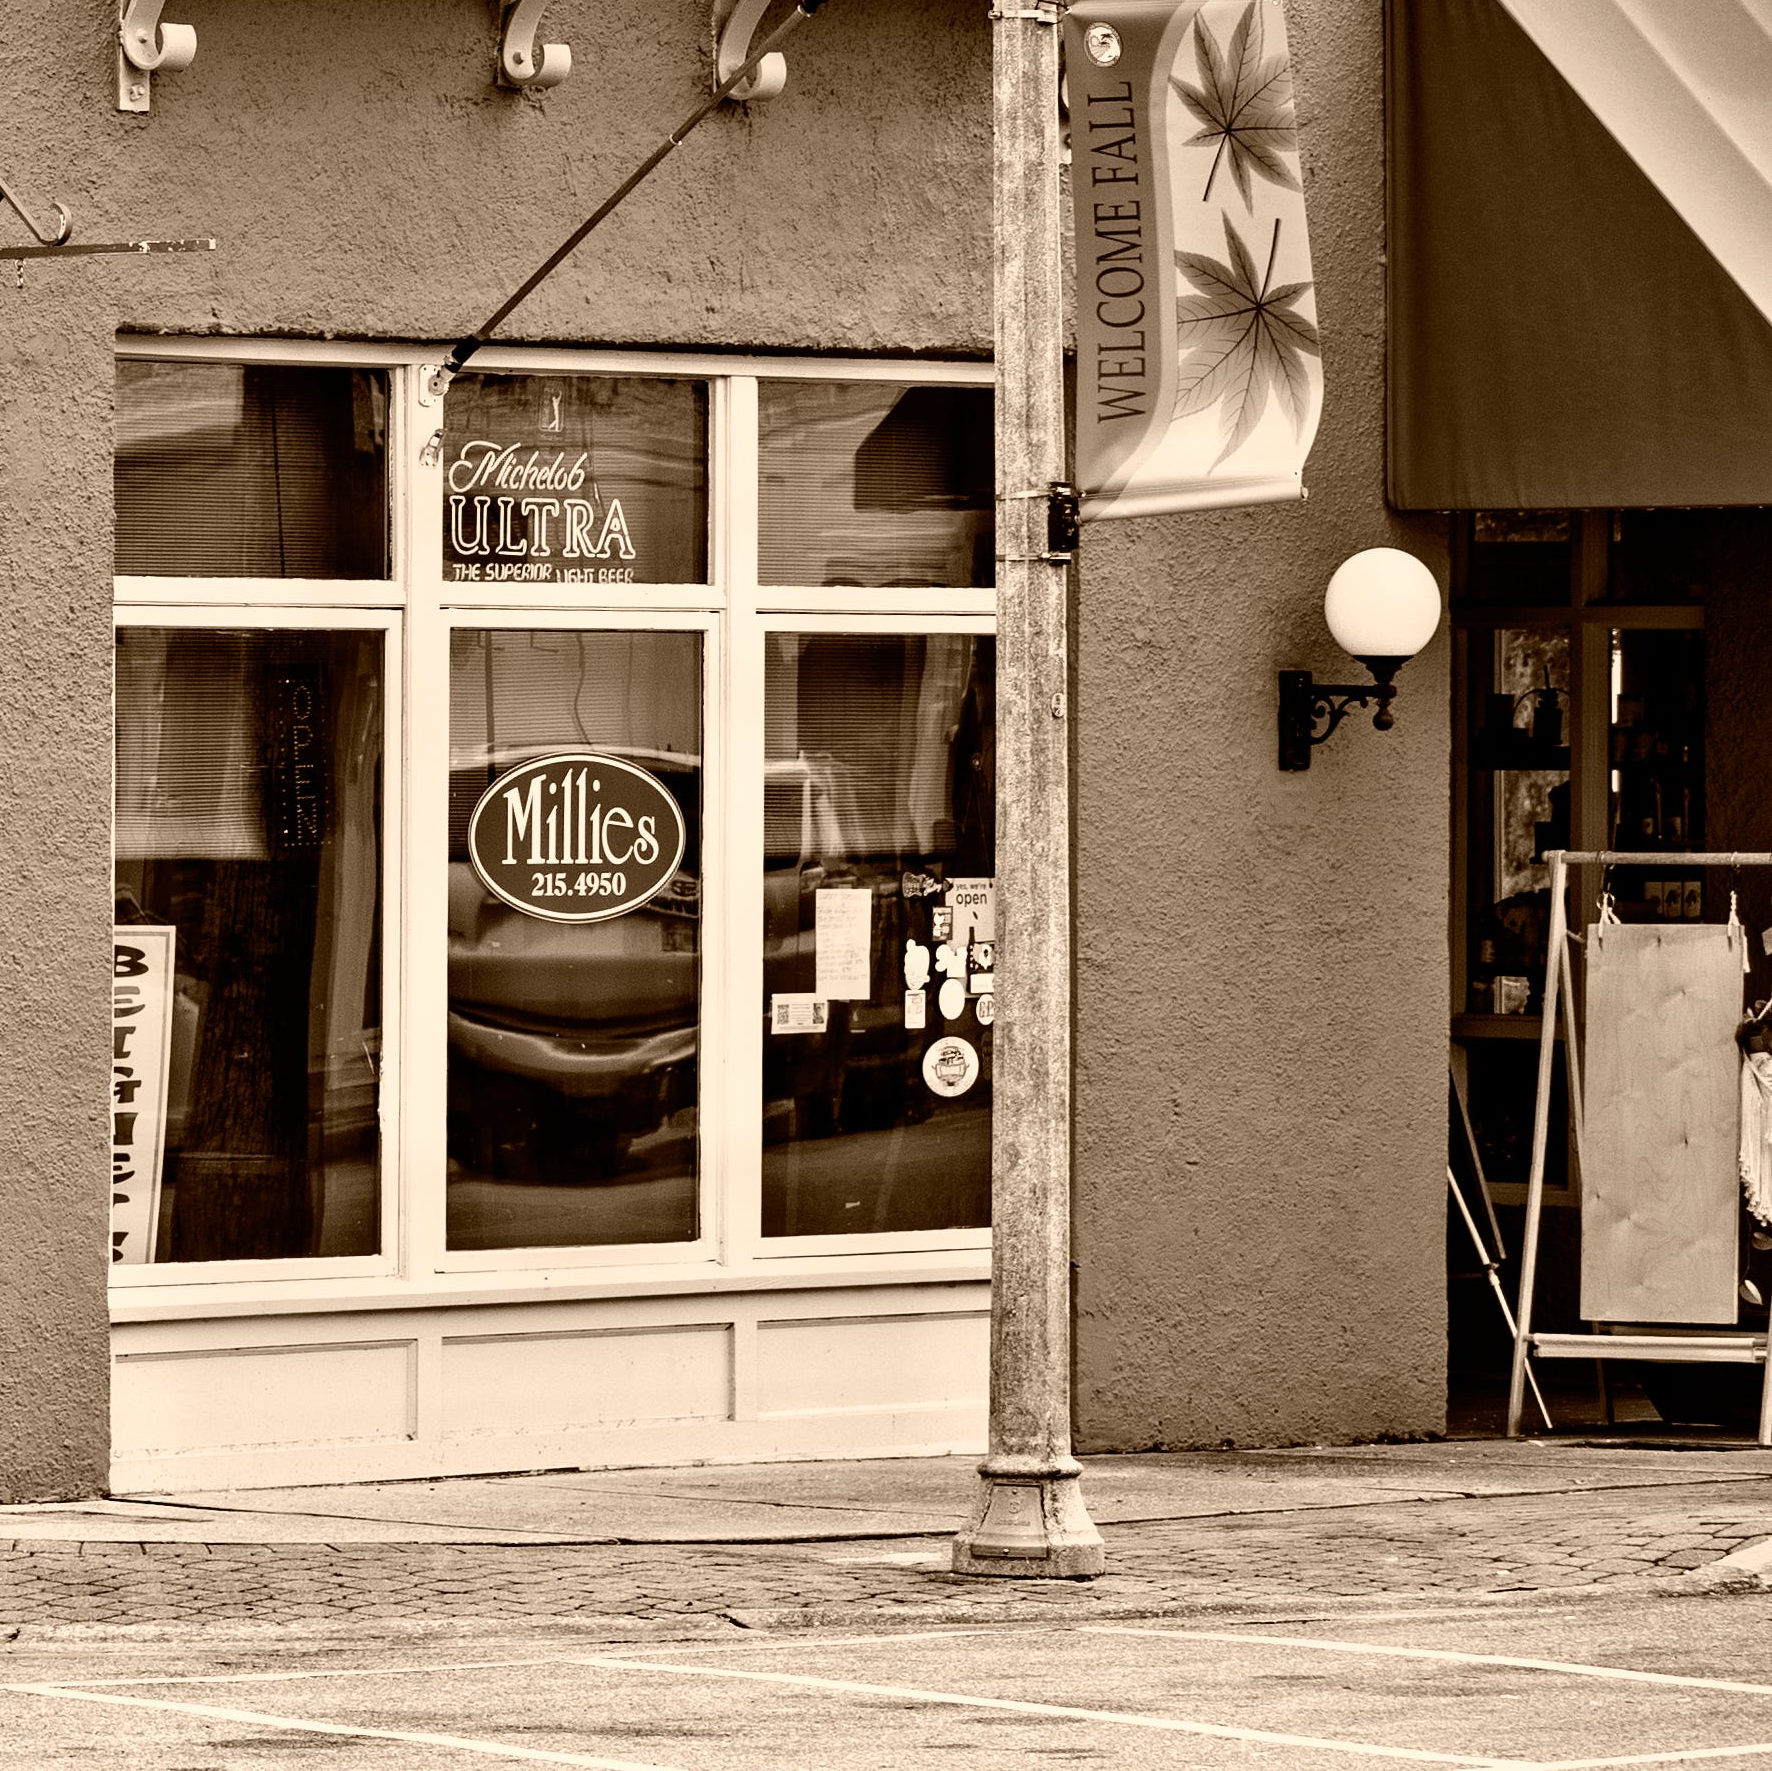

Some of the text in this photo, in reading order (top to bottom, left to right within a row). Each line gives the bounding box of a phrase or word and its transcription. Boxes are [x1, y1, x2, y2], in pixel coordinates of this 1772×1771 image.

[1086, 81, 1147, 424] WELCOME FALL
[449, 440, 588, 493] Michelob
[449, 495, 637, 560] ULTRA
[452, 563, 635, 585] THE SUPERIOR LIGHT BEER
[501, 766, 660, 866] Millies
[530, 871, 627, 897] 215.4950
[955, 893, 988, 907] open
